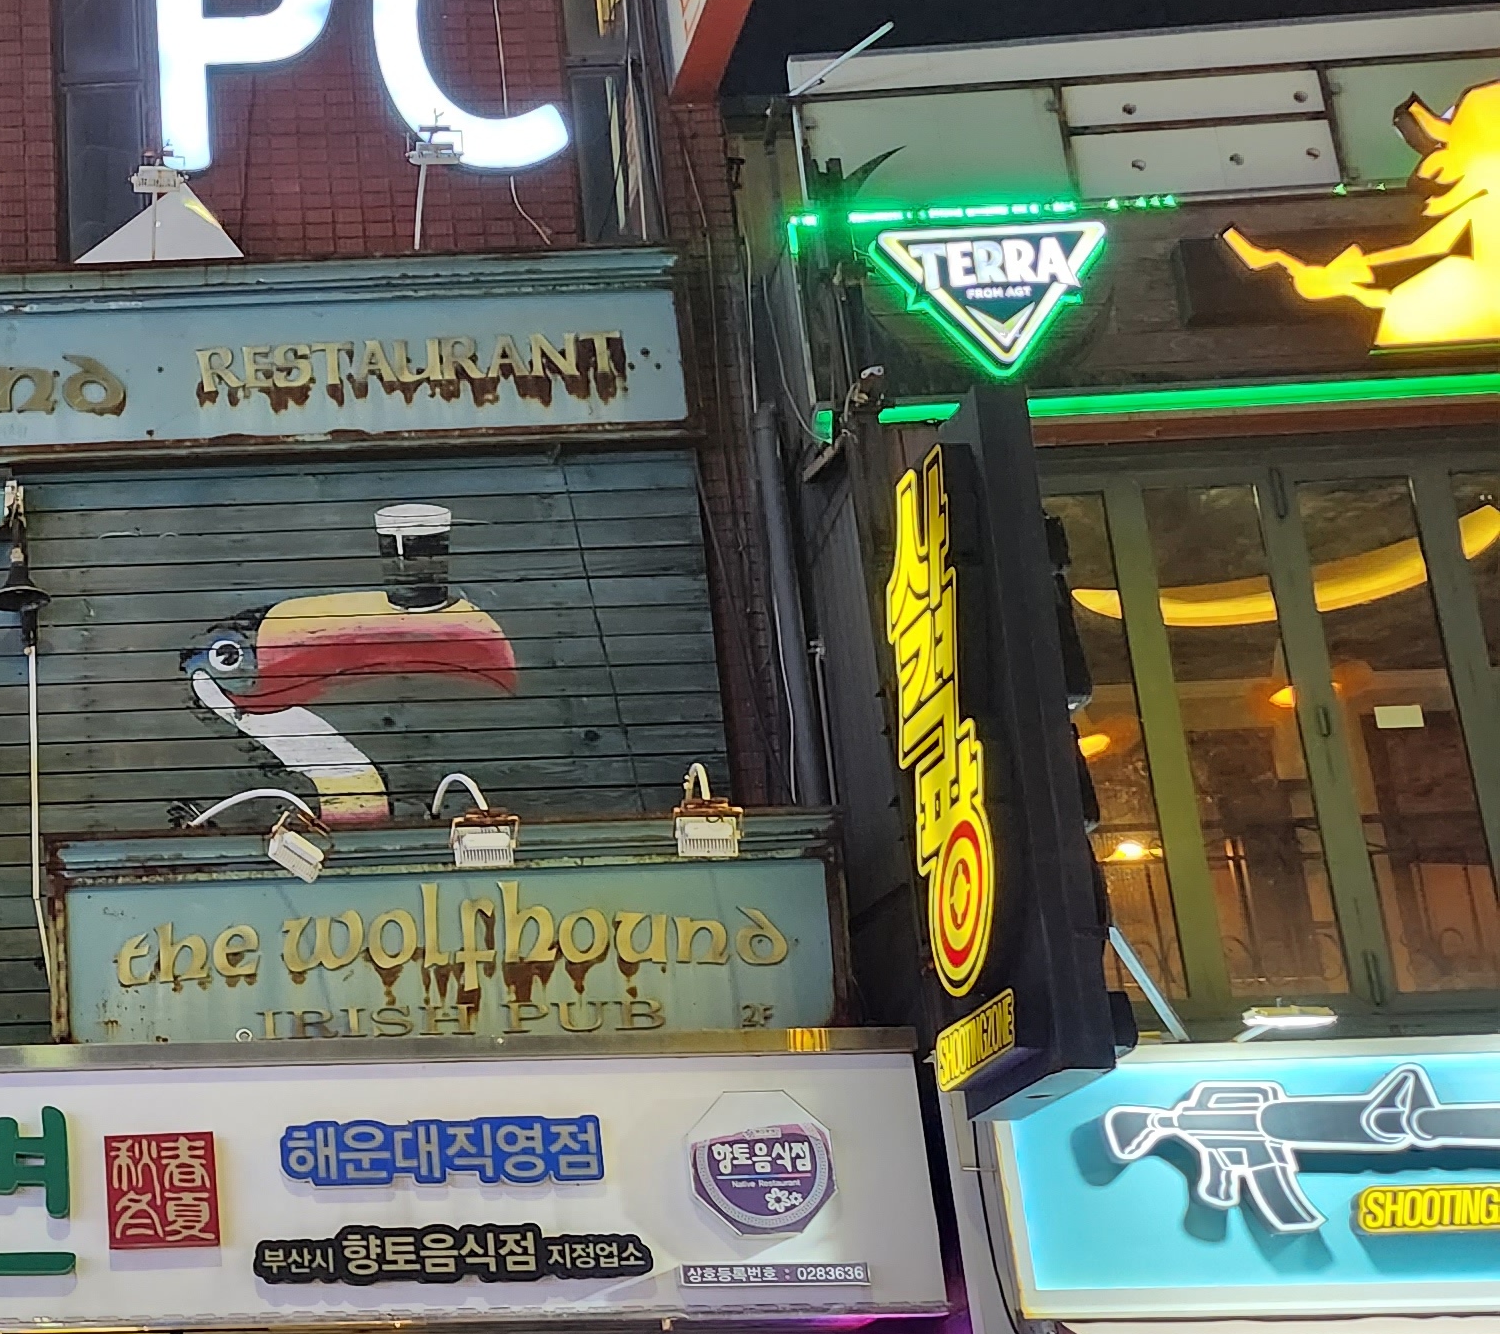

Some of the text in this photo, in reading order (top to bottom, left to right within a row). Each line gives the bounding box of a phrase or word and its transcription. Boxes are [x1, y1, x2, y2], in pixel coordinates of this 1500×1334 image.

[908, 236, 1082, 291] TERRA
[197, 329, 623, 393] RESTAURANT
[114, 879, 789, 991] the wolfhound
[258, 998, 775, 1041] IRISH PUB 2F
[285, 1116, 605, 1185] 해운대직영점
[711, 1140, 812, 1174] 향토음식점
[260, 1224, 647, 1276] 부산시 향토음식점 지정업소
[687, 1266, 865, 1283] 상호등록번호 0283636
